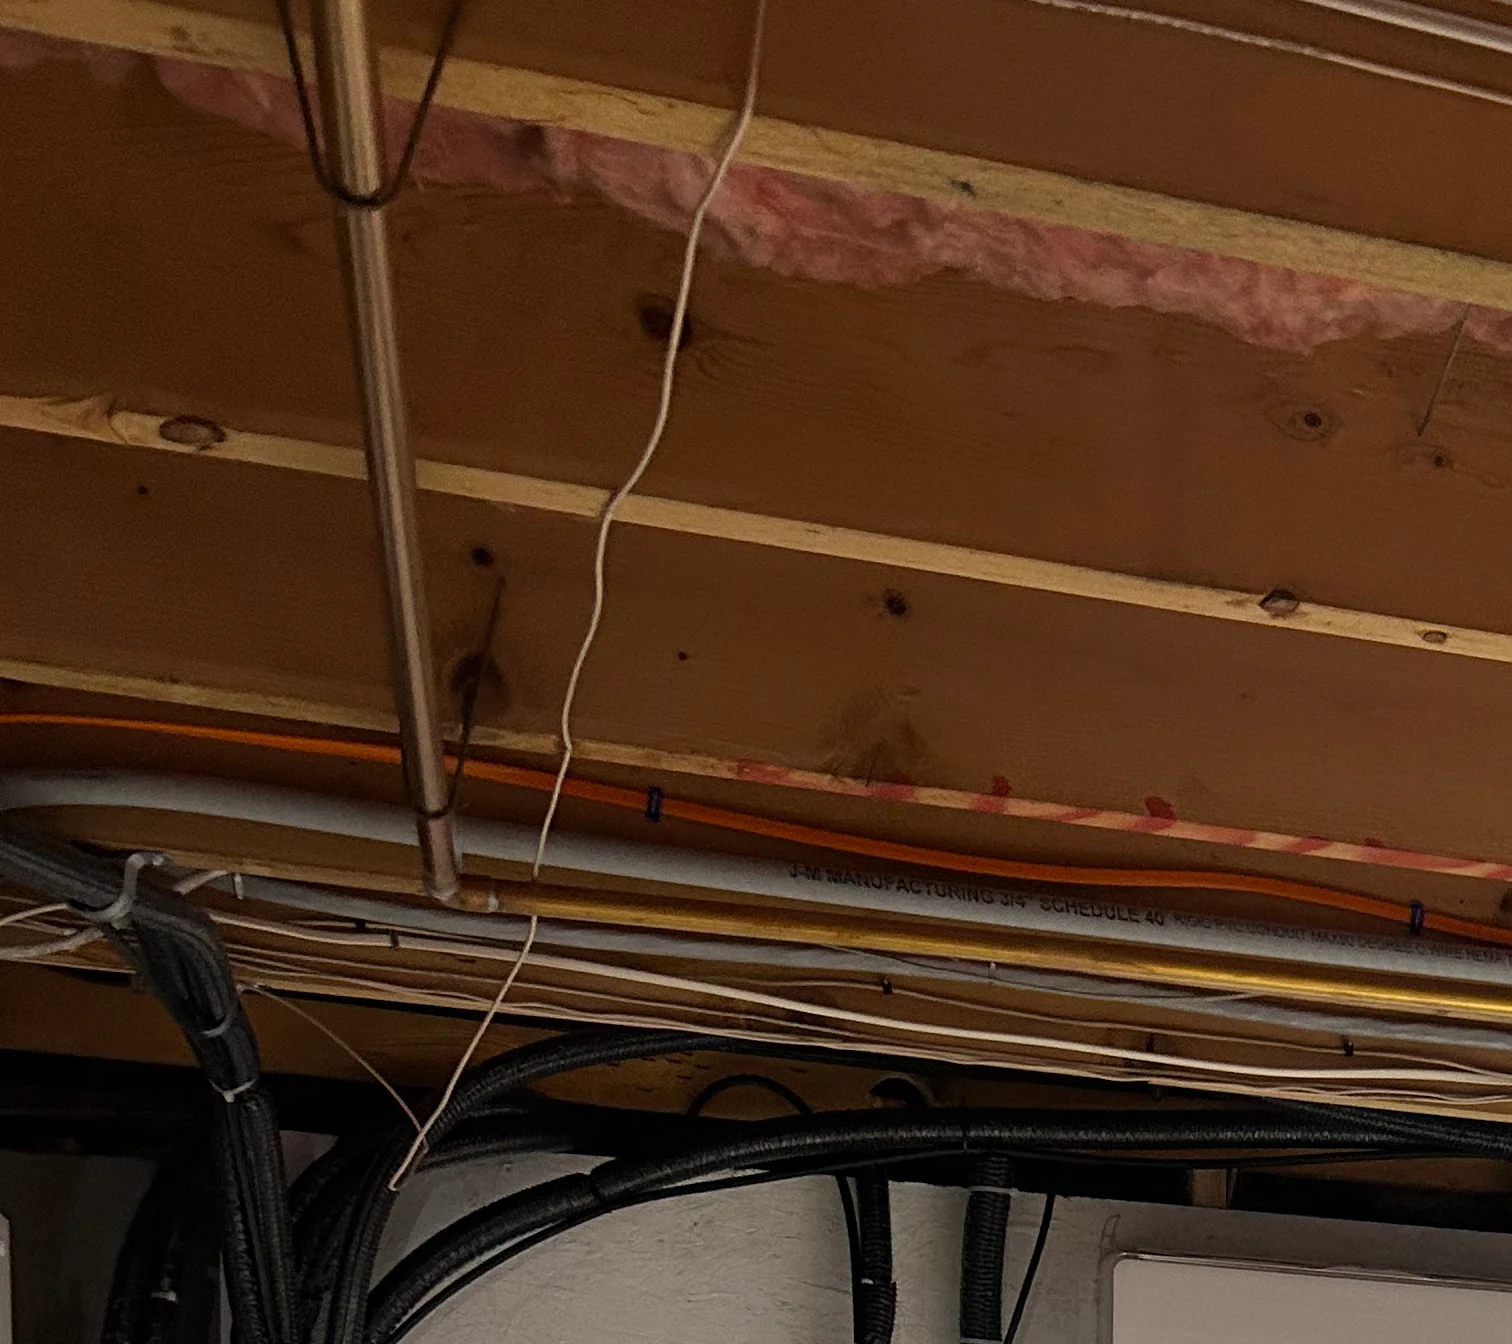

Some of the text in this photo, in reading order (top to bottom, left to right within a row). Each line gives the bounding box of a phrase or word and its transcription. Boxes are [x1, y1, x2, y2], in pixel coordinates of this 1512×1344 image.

[826, 868, 995, 905] MANUFACTURING
[1039, 896, 1140, 925] SCHEDULE
[1145, 909, 1165, 927] 40
